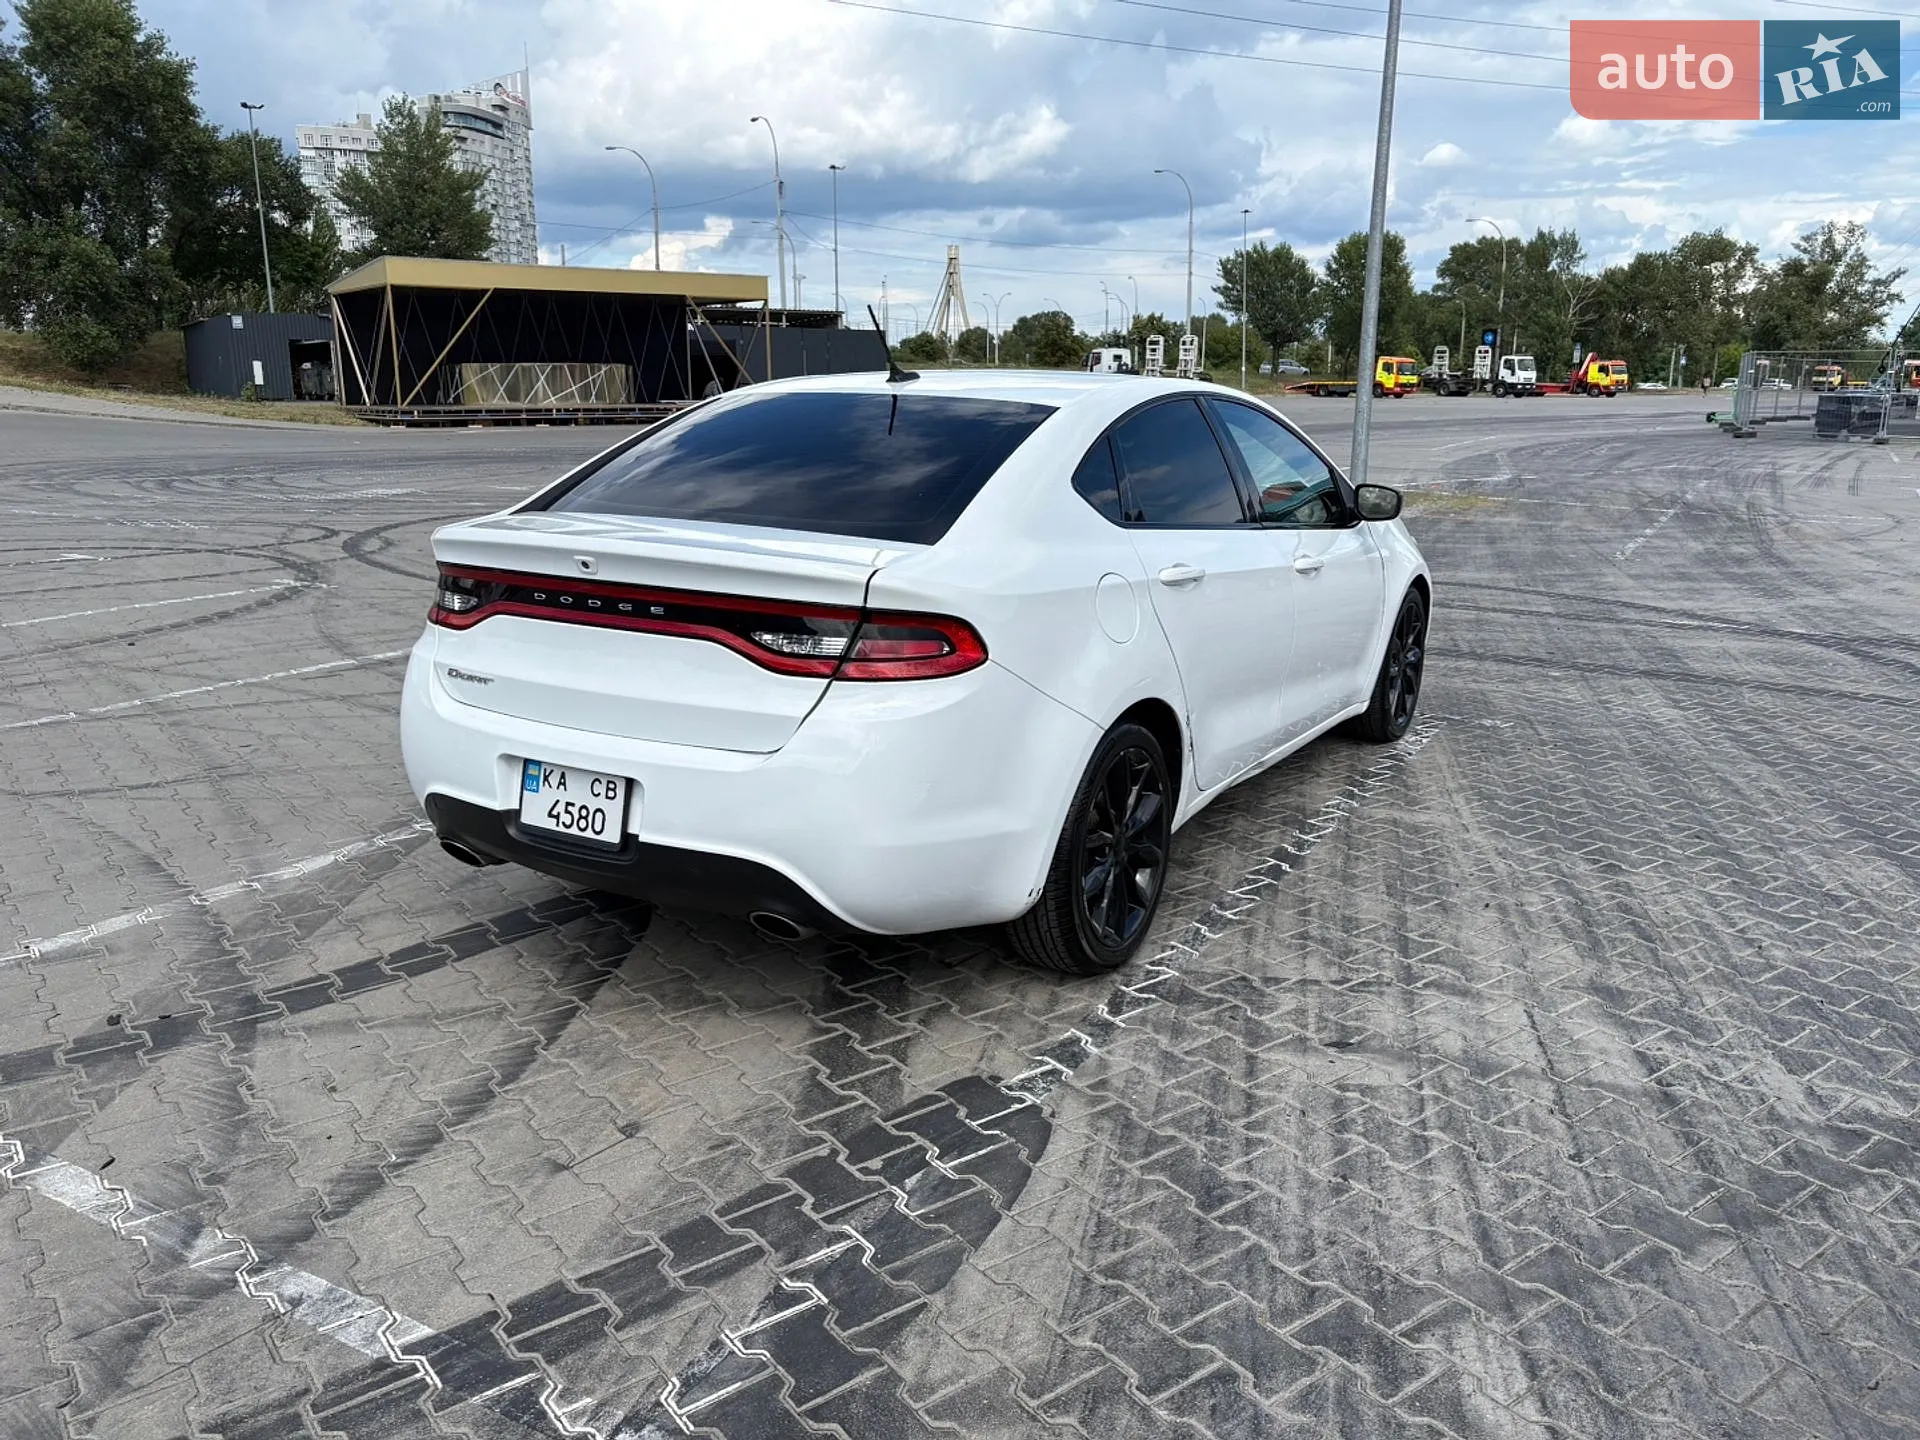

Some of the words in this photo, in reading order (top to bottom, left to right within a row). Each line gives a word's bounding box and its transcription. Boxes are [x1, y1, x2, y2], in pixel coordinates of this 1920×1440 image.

[534, 592, 665, 615] DODGE
[542, 767, 567, 792] KA
[590, 777, 617, 801] CB
[547, 799, 606, 836] 4580
